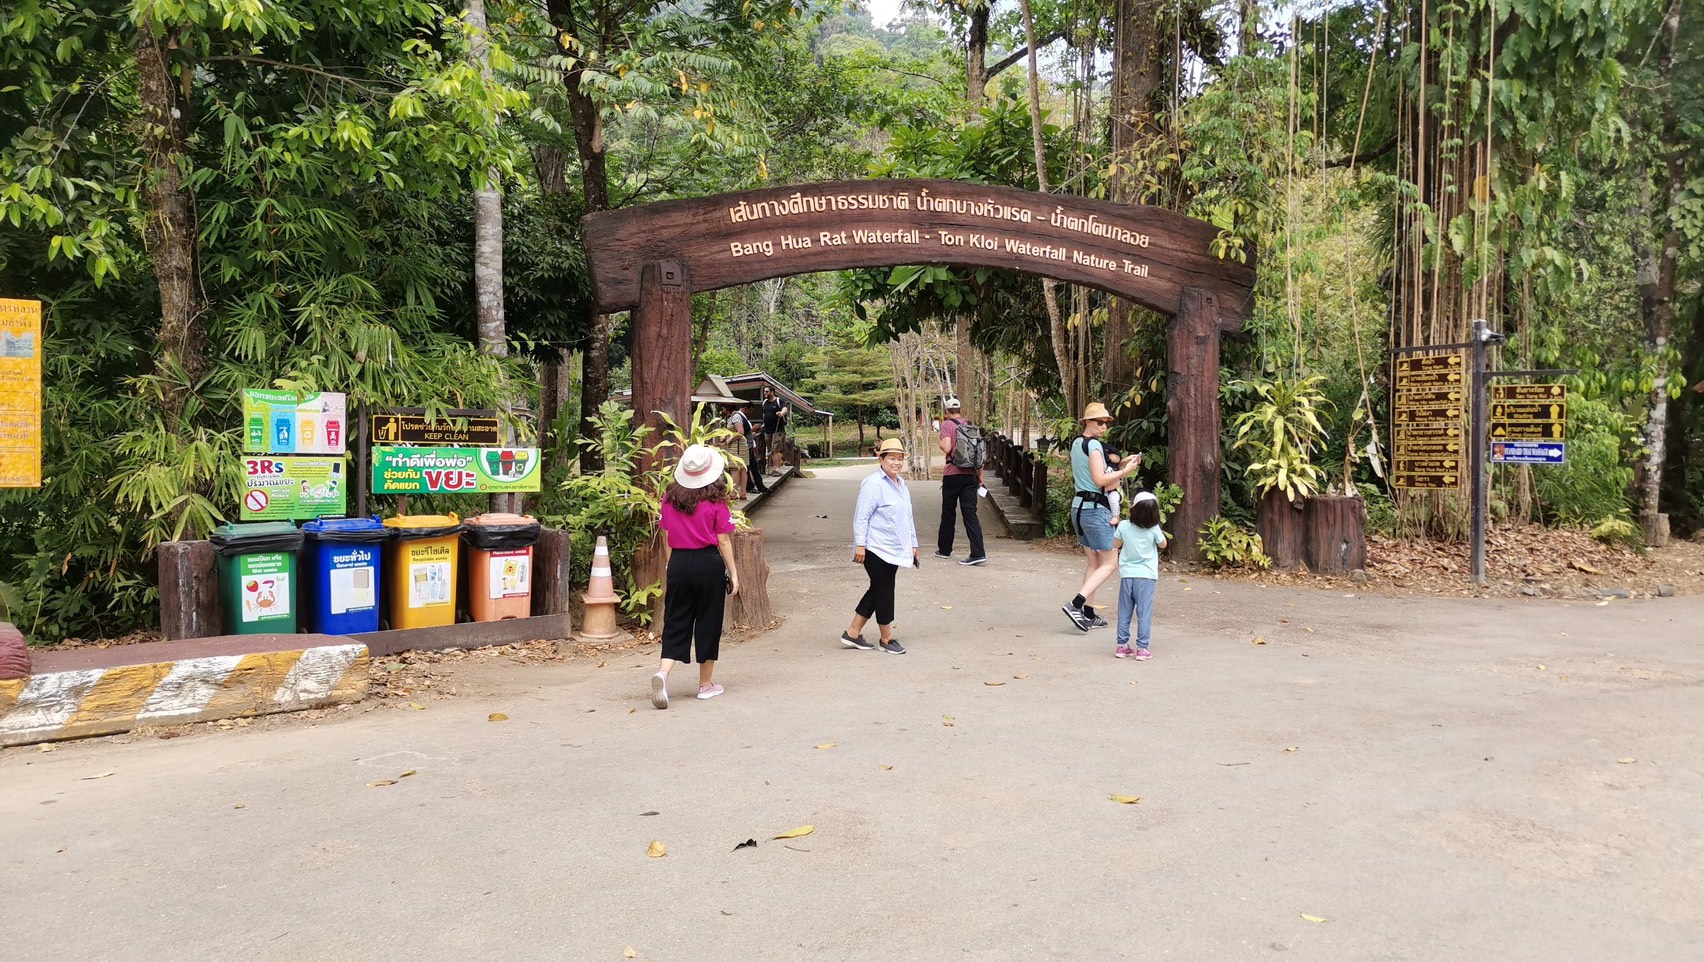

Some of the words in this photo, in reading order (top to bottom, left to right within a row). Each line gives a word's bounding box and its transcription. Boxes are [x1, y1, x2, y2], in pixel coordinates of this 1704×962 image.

[730, 191, 910, 223] เส้นทางศึกษาธรรมชาติ
[916, 188, 1032, 223] น้ำตกบางหัวแรด
[1050, 205, 1150, 248] น้ำตกโตนกลอย
[730, 240, 774, 257] Bang
[780, 234, 812, 250] Hua
[819, 231, 847, 247] Rat
[852, 229, 919, 244] Waterfall
[938, 231, 964, 246] Ton
[969, 234, 998, 251] Kloi
[1004, 238, 1066, 262] Waterfall
[1072, 250, 1117, 272] Nature
[1122, 259, 1149, 278] Trail
[424, 432, 443, 440] KEEP
[444, 433, 469, 441] CLEAN
[246, 459, 284, 475] 3Rs
[384, 468, 420, 479] ช่วยกัน
[384, 480, 420, 490] คัดแยก
[423, 470, 476, 491] ขยะ
[333, 550, 371, 563] ขยะทั่วไป
